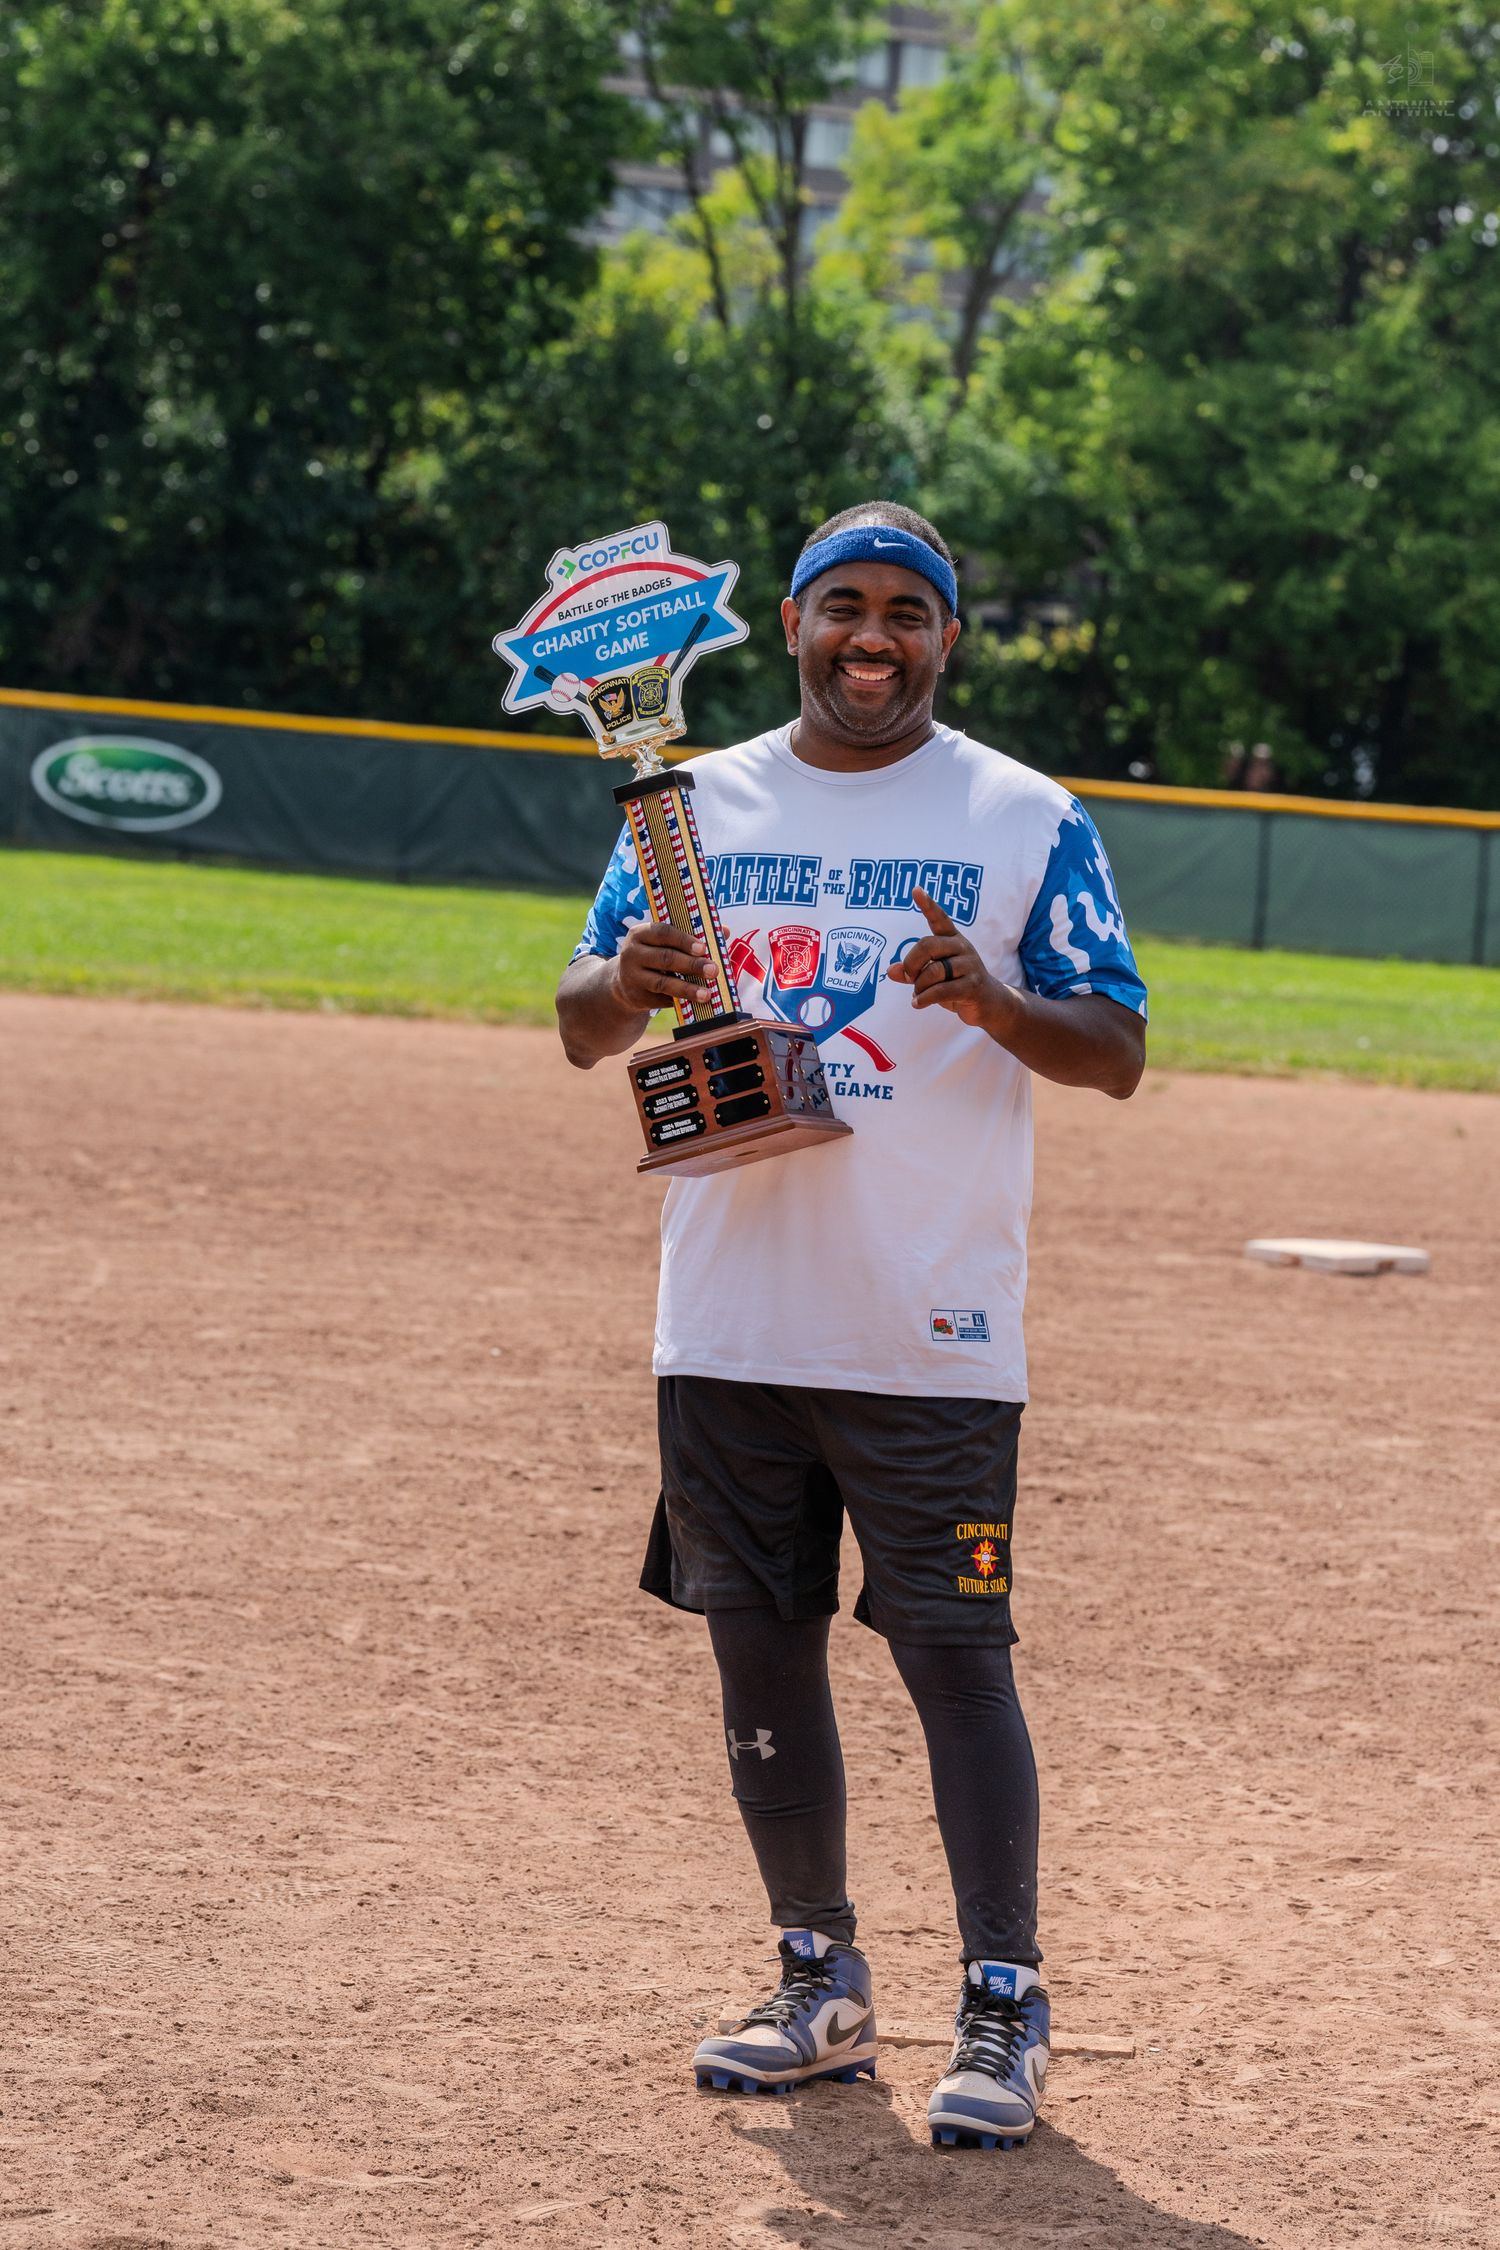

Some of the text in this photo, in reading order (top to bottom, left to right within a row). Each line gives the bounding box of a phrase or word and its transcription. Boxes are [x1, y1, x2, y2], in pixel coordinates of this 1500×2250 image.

[578, 532, 660, 572] COPFCU
[557, 577, 672, 621] BATTLE OF THE BADGES
[532, 591, 706, 658] CHARITY SOFTBALL
[595, 632, 650, 661] GAME
[589, 678, 630, 701] CINCINNATI
[606, 714, 632, 730] POLICE
[704, 853, 984, 927] ATTLE OF THE BADGES
[777, 927, 811, 935] CINCINNATI
[830, 931, 883, 948] CINCINNATI
[826, 977, 860, 989] POLICE
[835, 1081, 894, 1100] GAME
[956, 1523, 1008, 1540] CINCINNATI
[957, 1575, 1008, 1594] FUTURE STARS
[790, 1939, 805, 1950] NIKE
[800, 1946, 812, 1956] AIR
[988, 1975, 1007, 1986] NIKE
[998, 1985, 1013, 1995] AIR
